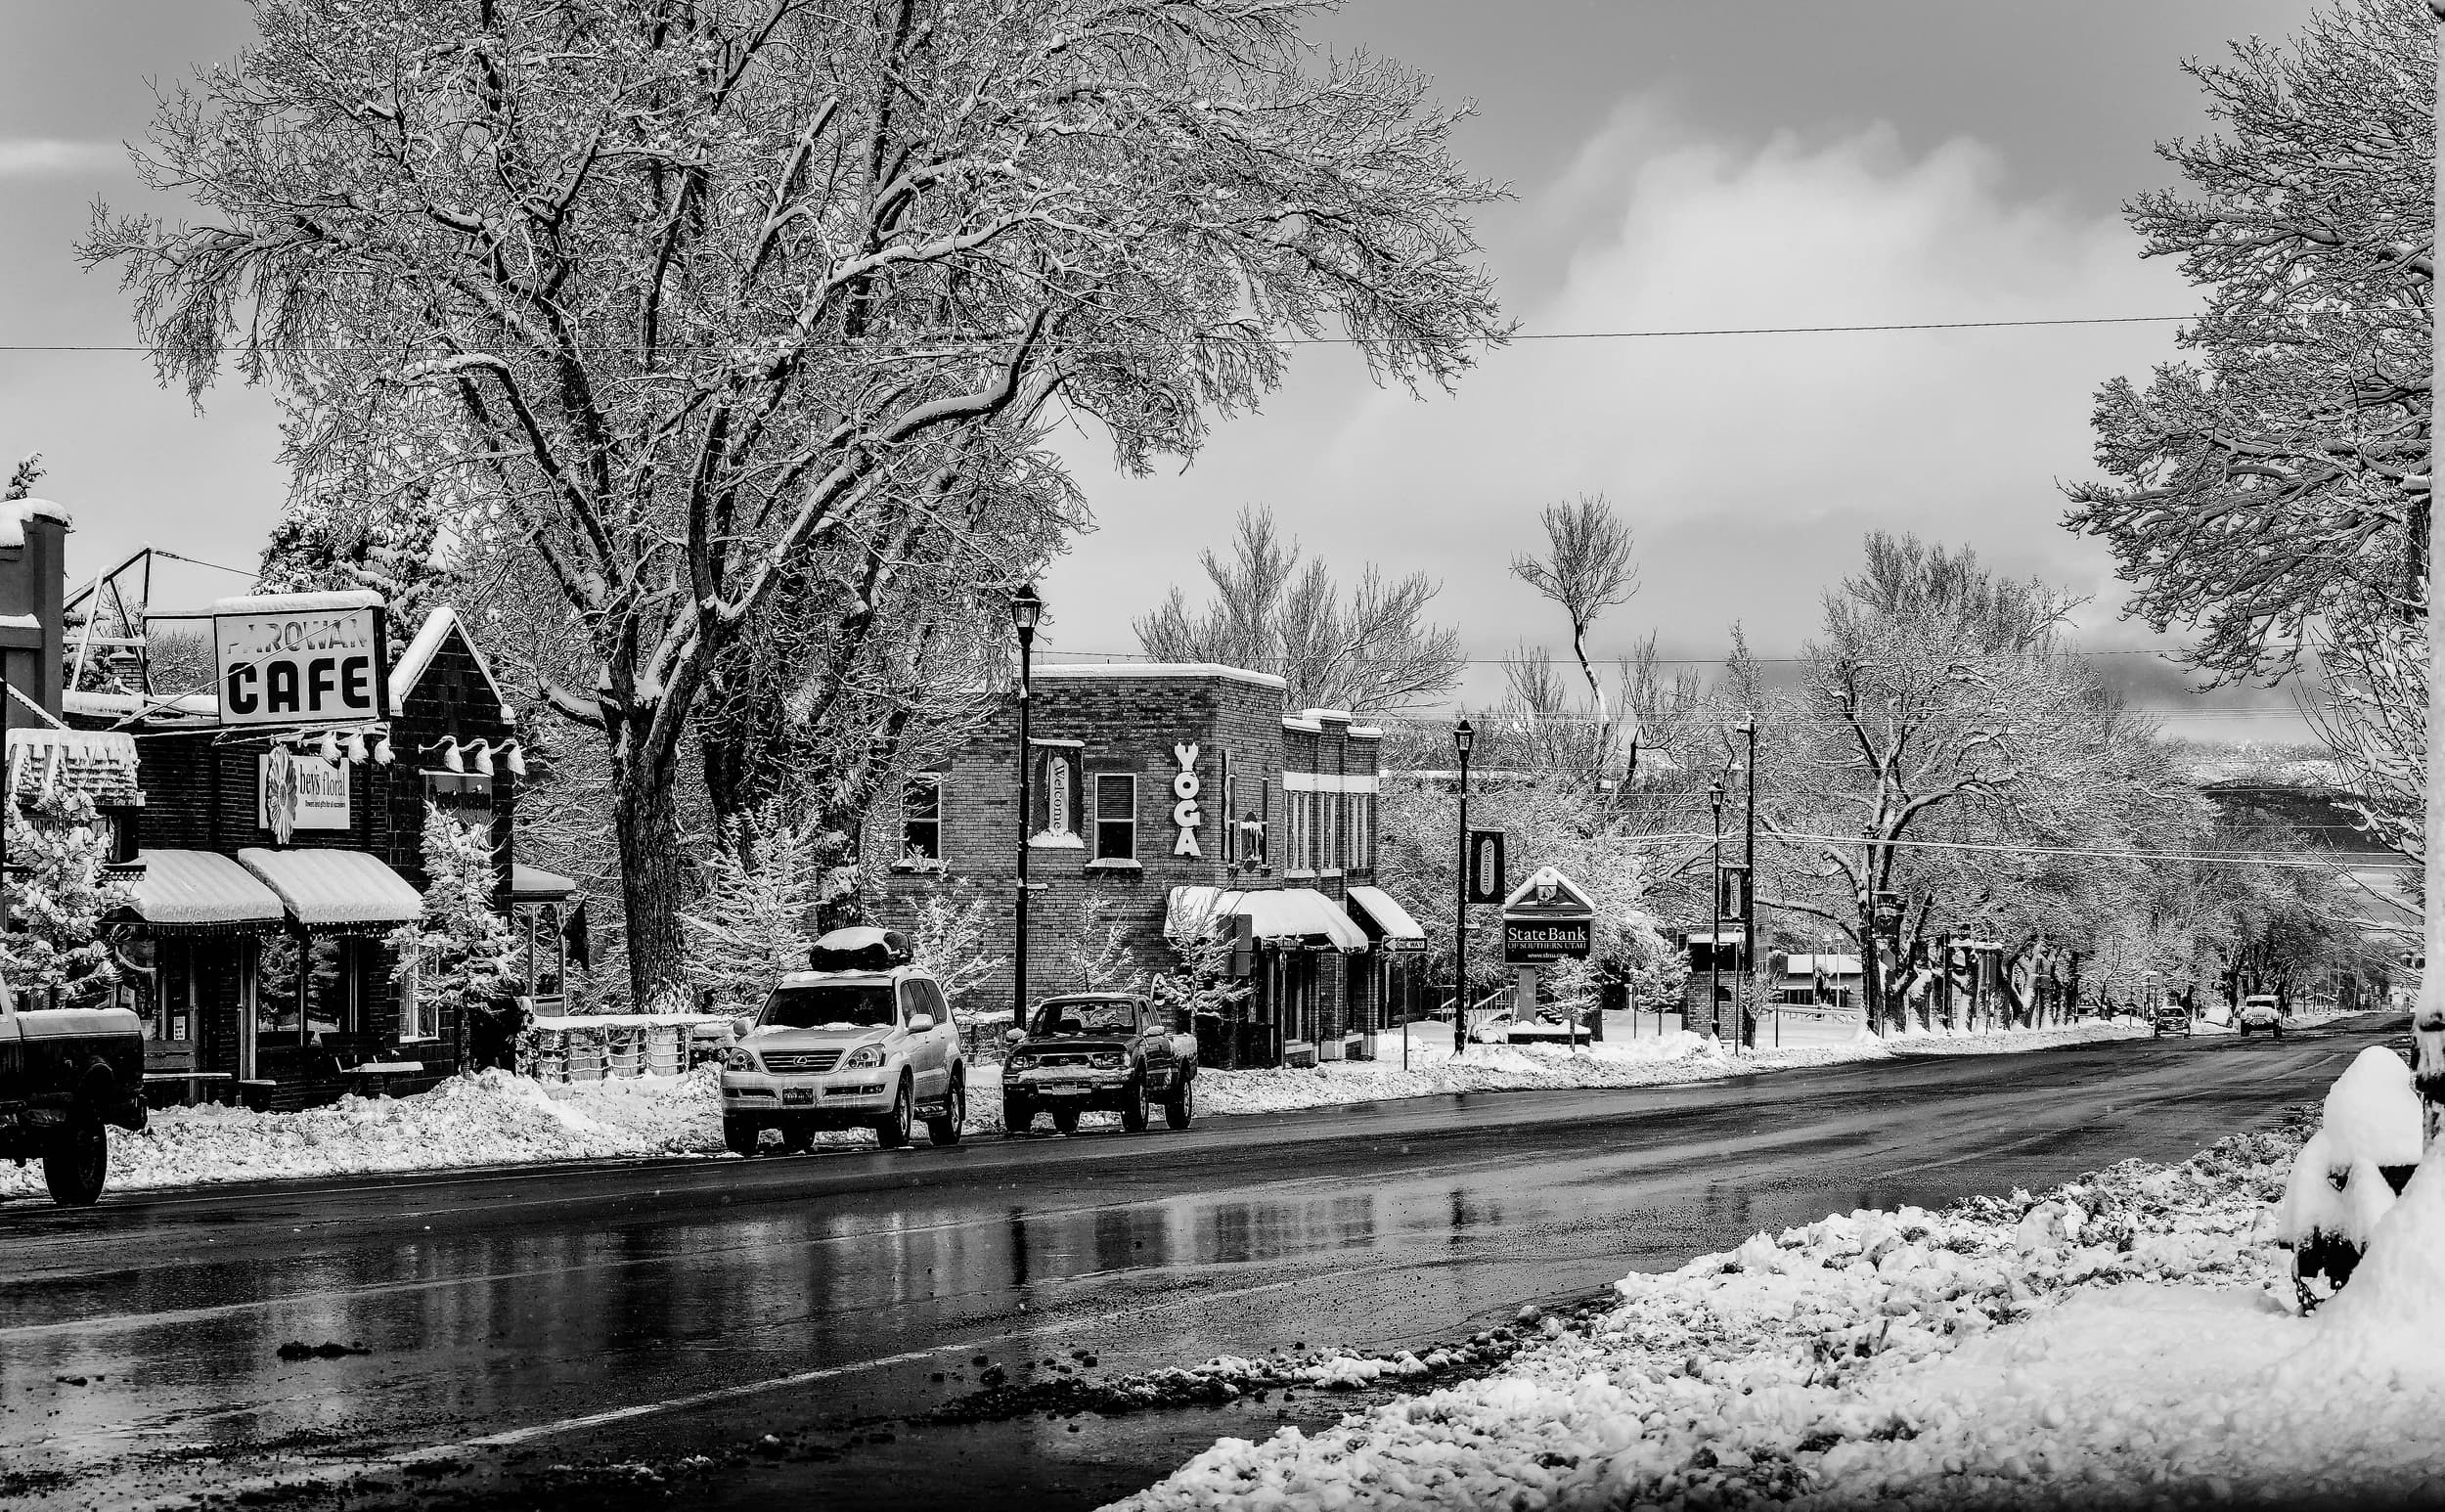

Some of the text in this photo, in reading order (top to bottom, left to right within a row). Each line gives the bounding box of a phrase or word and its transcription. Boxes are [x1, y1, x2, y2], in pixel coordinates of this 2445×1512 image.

[228, 656, 370, 714] CAFE
[299, 764, 345, 796] bev's floral
[1054, 765, 1065, 829] Welcome
[1174, 742, 1202, 857] YOGA
[1508, 926, 1586, 941] State Bank
